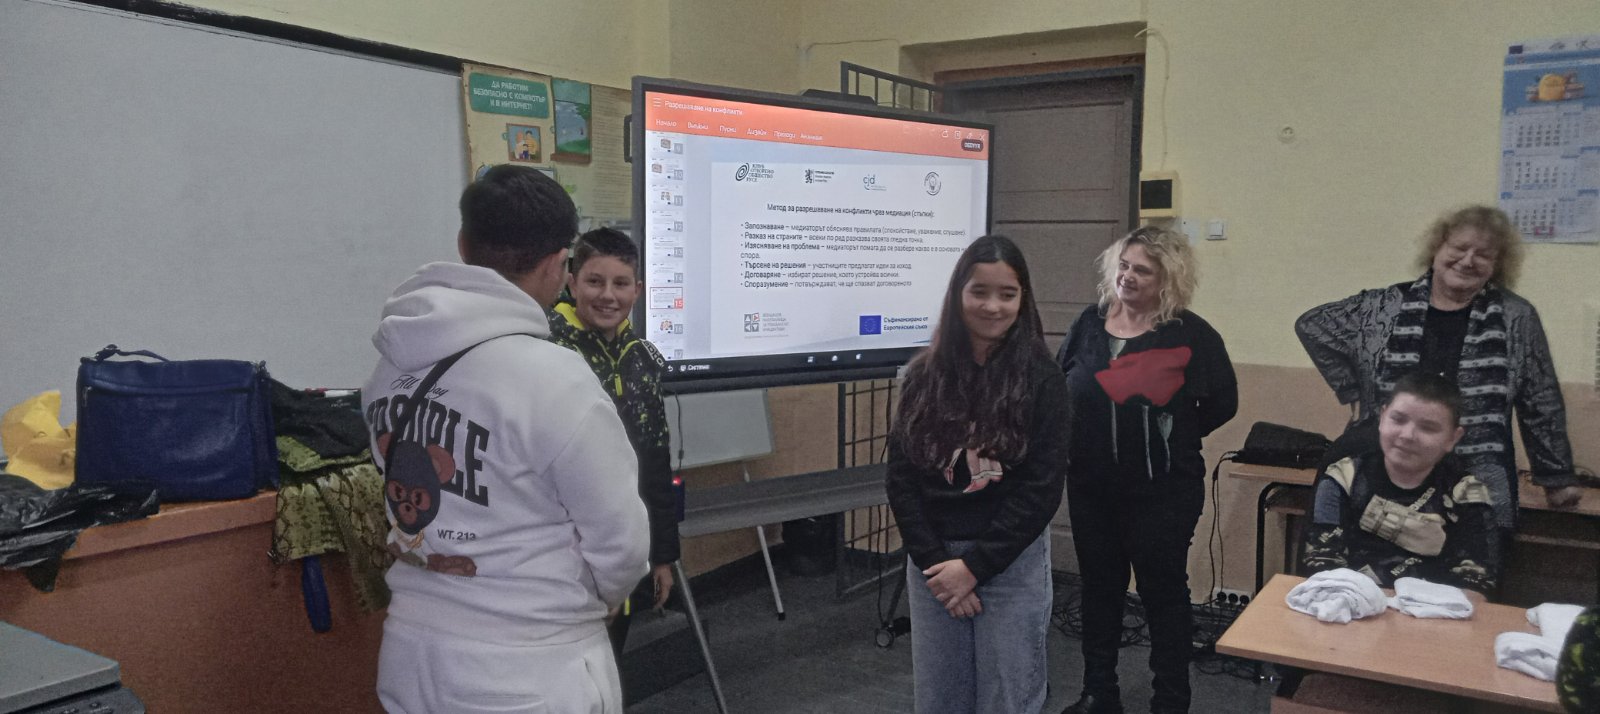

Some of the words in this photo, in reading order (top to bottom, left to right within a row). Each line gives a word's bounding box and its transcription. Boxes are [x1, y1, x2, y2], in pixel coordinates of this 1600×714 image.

[491, 80, 500, 88] ДА
[501, 82, 528, 92] РАБОТИМ
[473, 88, 508, 98] БЕЗОПАСНО
[514, 92, 546, 102] КОМПЮТЪР
[664, 100, 704, 111] Разрешаване
[713, 107, 742, 116] конфликти
[656, 119, 677, 127] Начало
[863, 174, 875, 186] cjd
[767, 203, 786, 212] Метод
[912, 210, 934, 218] (стъпки):
[745, 222, 784, 230] Запознаване
[745, 232, 766, 240] Разказ
[791, 243, 820, 251] проблема
[744, 271, 781, 279] Договаряне
[744, 281, 788, 289] Споразумение
[391, 374, 421, 390] All
[437, 529, 454, 540] WT.
[456, 531, 476, 541] 213
